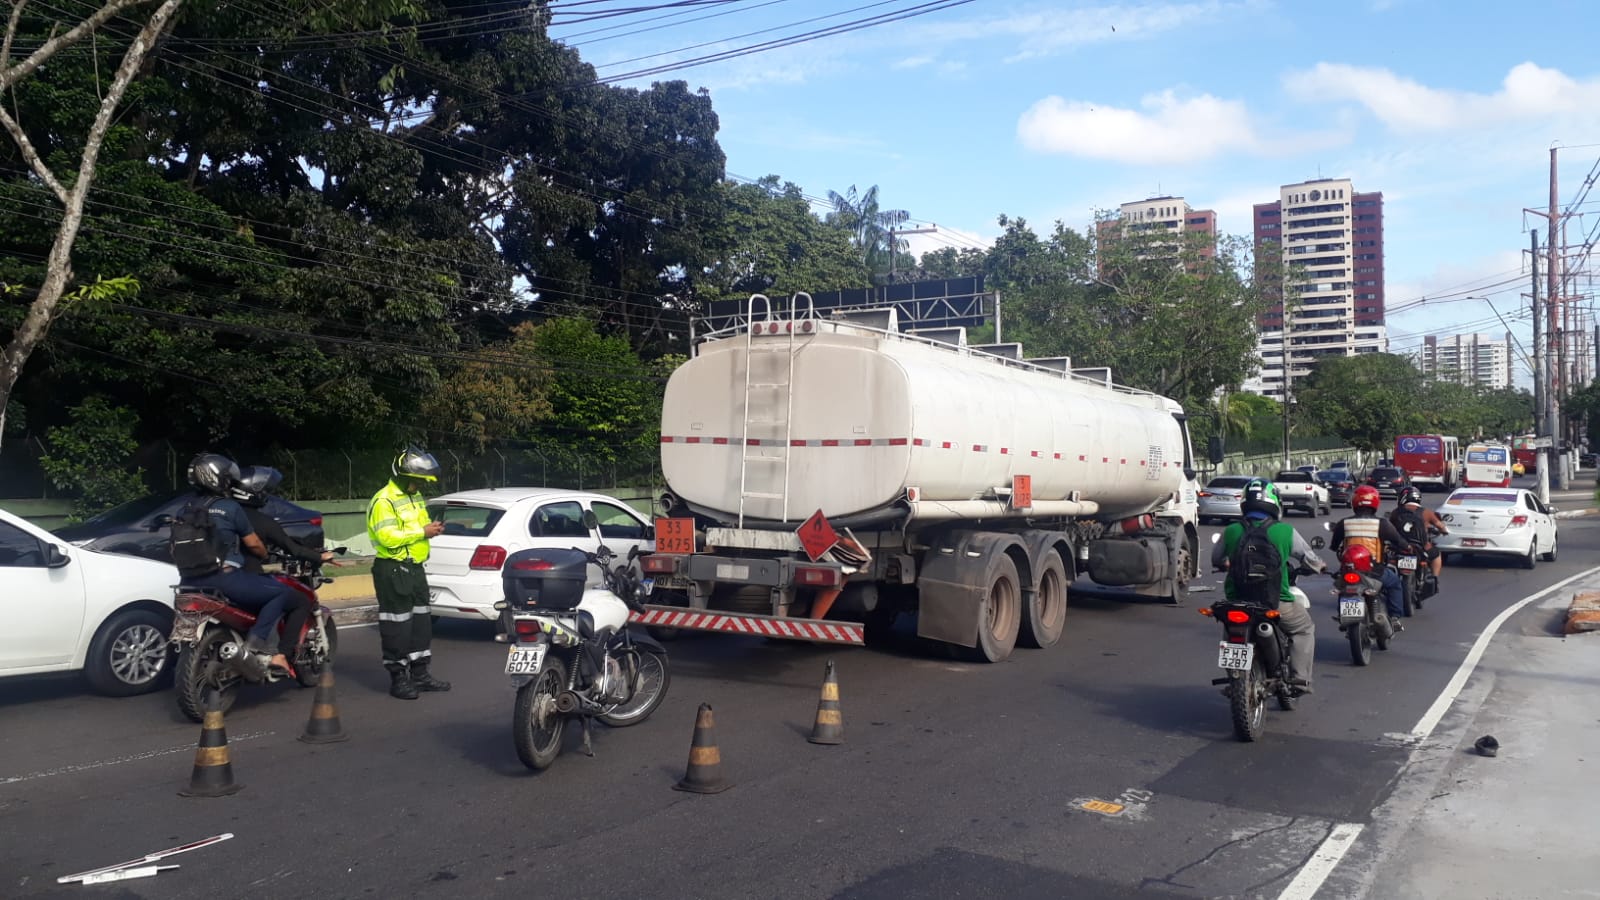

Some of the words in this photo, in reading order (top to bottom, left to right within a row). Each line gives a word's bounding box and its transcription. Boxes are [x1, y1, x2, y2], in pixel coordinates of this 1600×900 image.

[666, 521, 681, 534] 33
[659, 538, 690, 551] 3475
[1223, 648, 1248, 659] PHR
[508, 662, 537, 672] 6075
[1221, 657, 1247, 668] 3287
